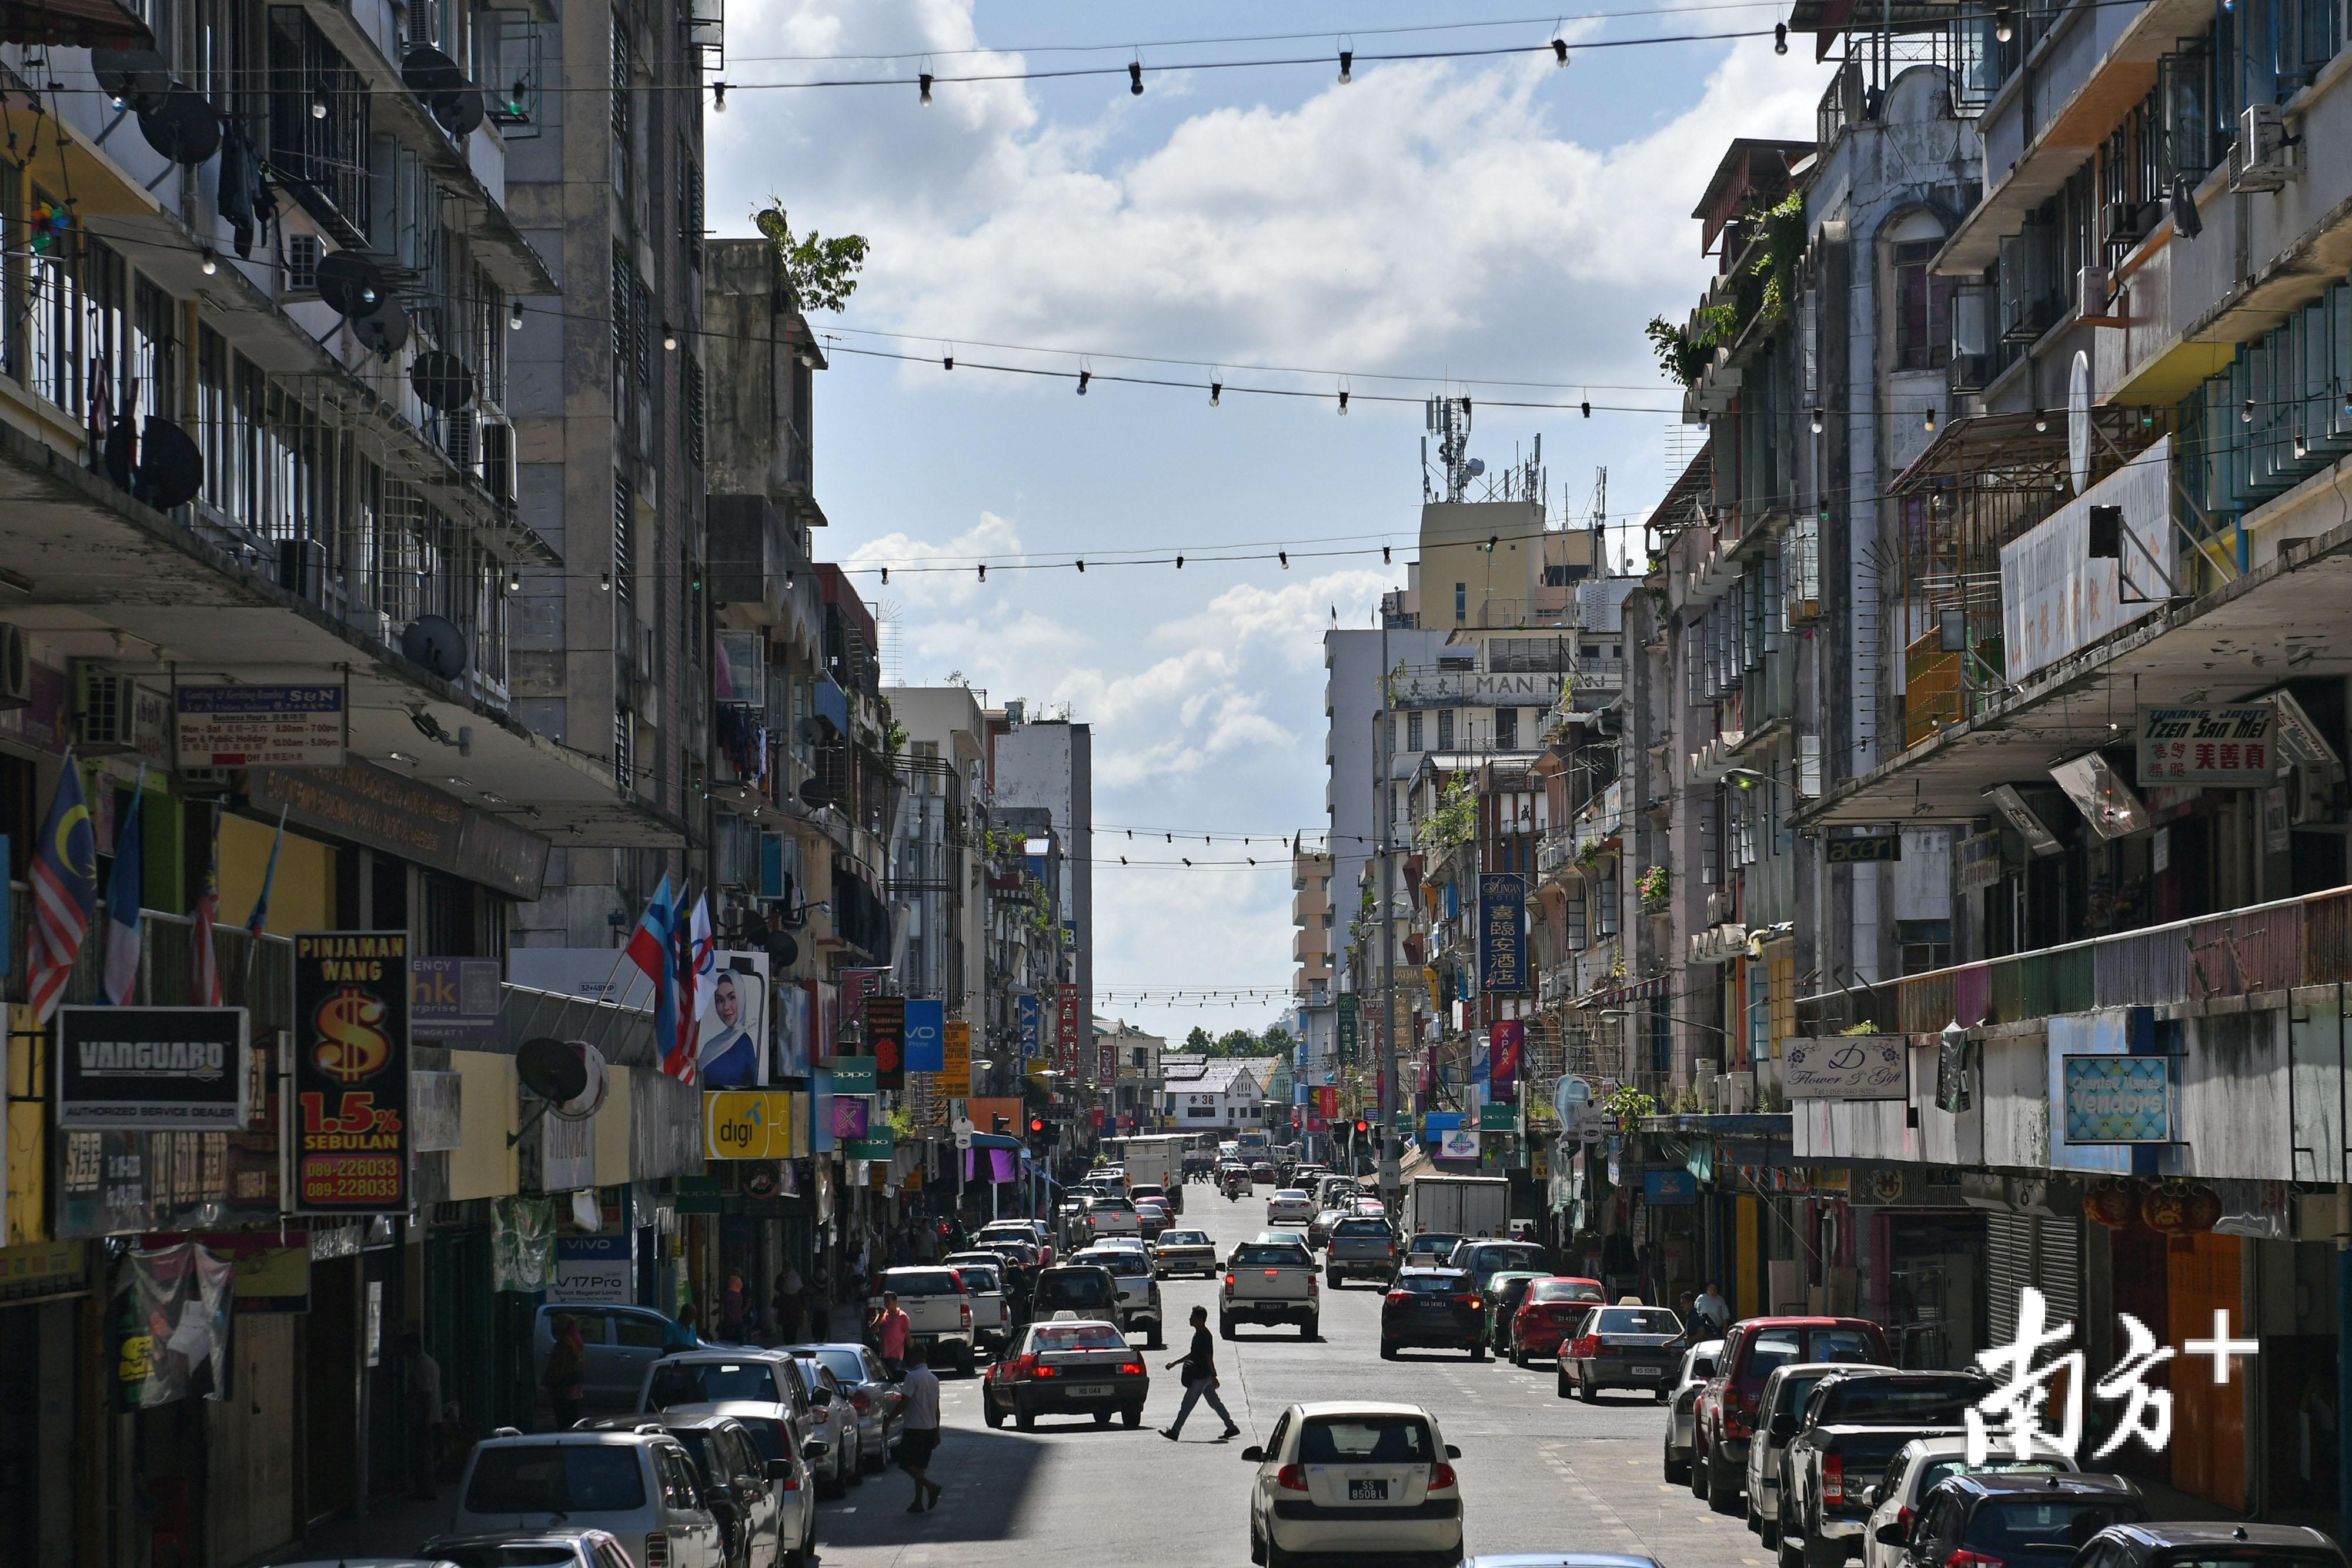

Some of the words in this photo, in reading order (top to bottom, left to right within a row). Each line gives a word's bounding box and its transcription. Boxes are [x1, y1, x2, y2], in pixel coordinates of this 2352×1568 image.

[1476, 676, 1534, 694] MAN
[2150, 710, 2211, 720] TUKANG
[2219, 710, 2268, 719] JAHIT
[206, 724, 220, 733] Sat
[236, 735, 268, 744] Holiday
[311, 738, 339, 747] 5.00pm
[1830, 838, 1890, 861] acer
[299, 938, 404, 958] PINJAMAN
[1489, 904, 1516, 985] 喜臨安酒店
[320, 960, 383, 981] WANG
[412, 1004, 457, 1014] rprise
[1021, 1004, 1036, 1065] ONY
[79, 1042, 224, 1068] VANGUARD
[1828, 1042, 1866, 1069] D
[1788, 1069, 1843, 1086] Flower
[1867, 1066, 1902, 1086] Gift
[1202, 1095, 1214, 1105] 38
[2072, 1091, 2163, 1114] Vendors
[67, 1107, 137, 1116] AUTHORIZED
[141, 1108, 188, 1116] SERVICE
[192, 1108, 234, 1117] DEALER
[300, 1092, 402, 1134] 1.5%
[720, 1118, 753, 1147] digi
[305, 1135, 398, 1150] SEBULAN
[307, 1160, 397, 1177] 089-226033
[307, 1179, 397, 1197] 089-228033
[566, 1237, 611, 1249] vivo
[1362, 1480, 1374, 1489] SS
[1352, 1490, 1376, 1499] 8508
[1379, 1490, 1384, 1499] L
